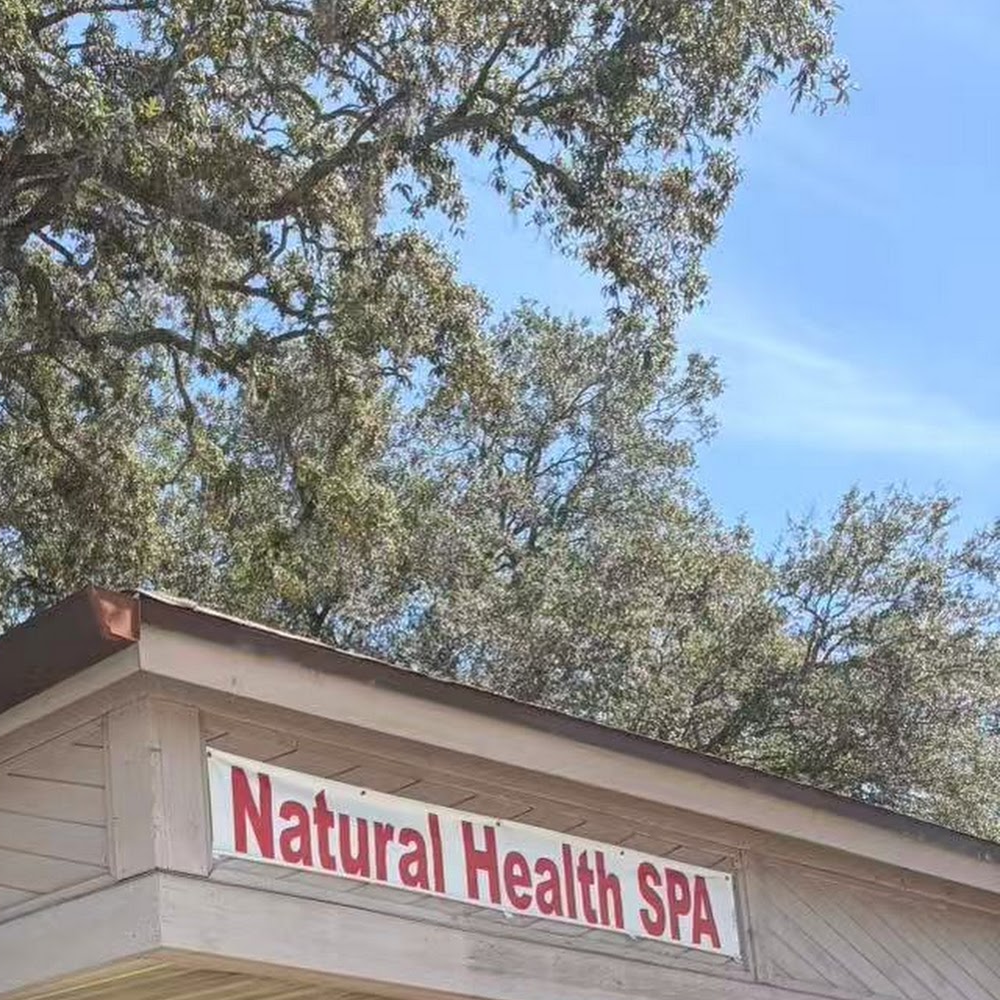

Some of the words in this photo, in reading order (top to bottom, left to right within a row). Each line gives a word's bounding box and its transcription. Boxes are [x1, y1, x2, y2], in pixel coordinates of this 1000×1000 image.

[230, 765, 446, 894] Natural
[461, 820, 624, 930] Health
[636, 860, 721, 950] SPA
